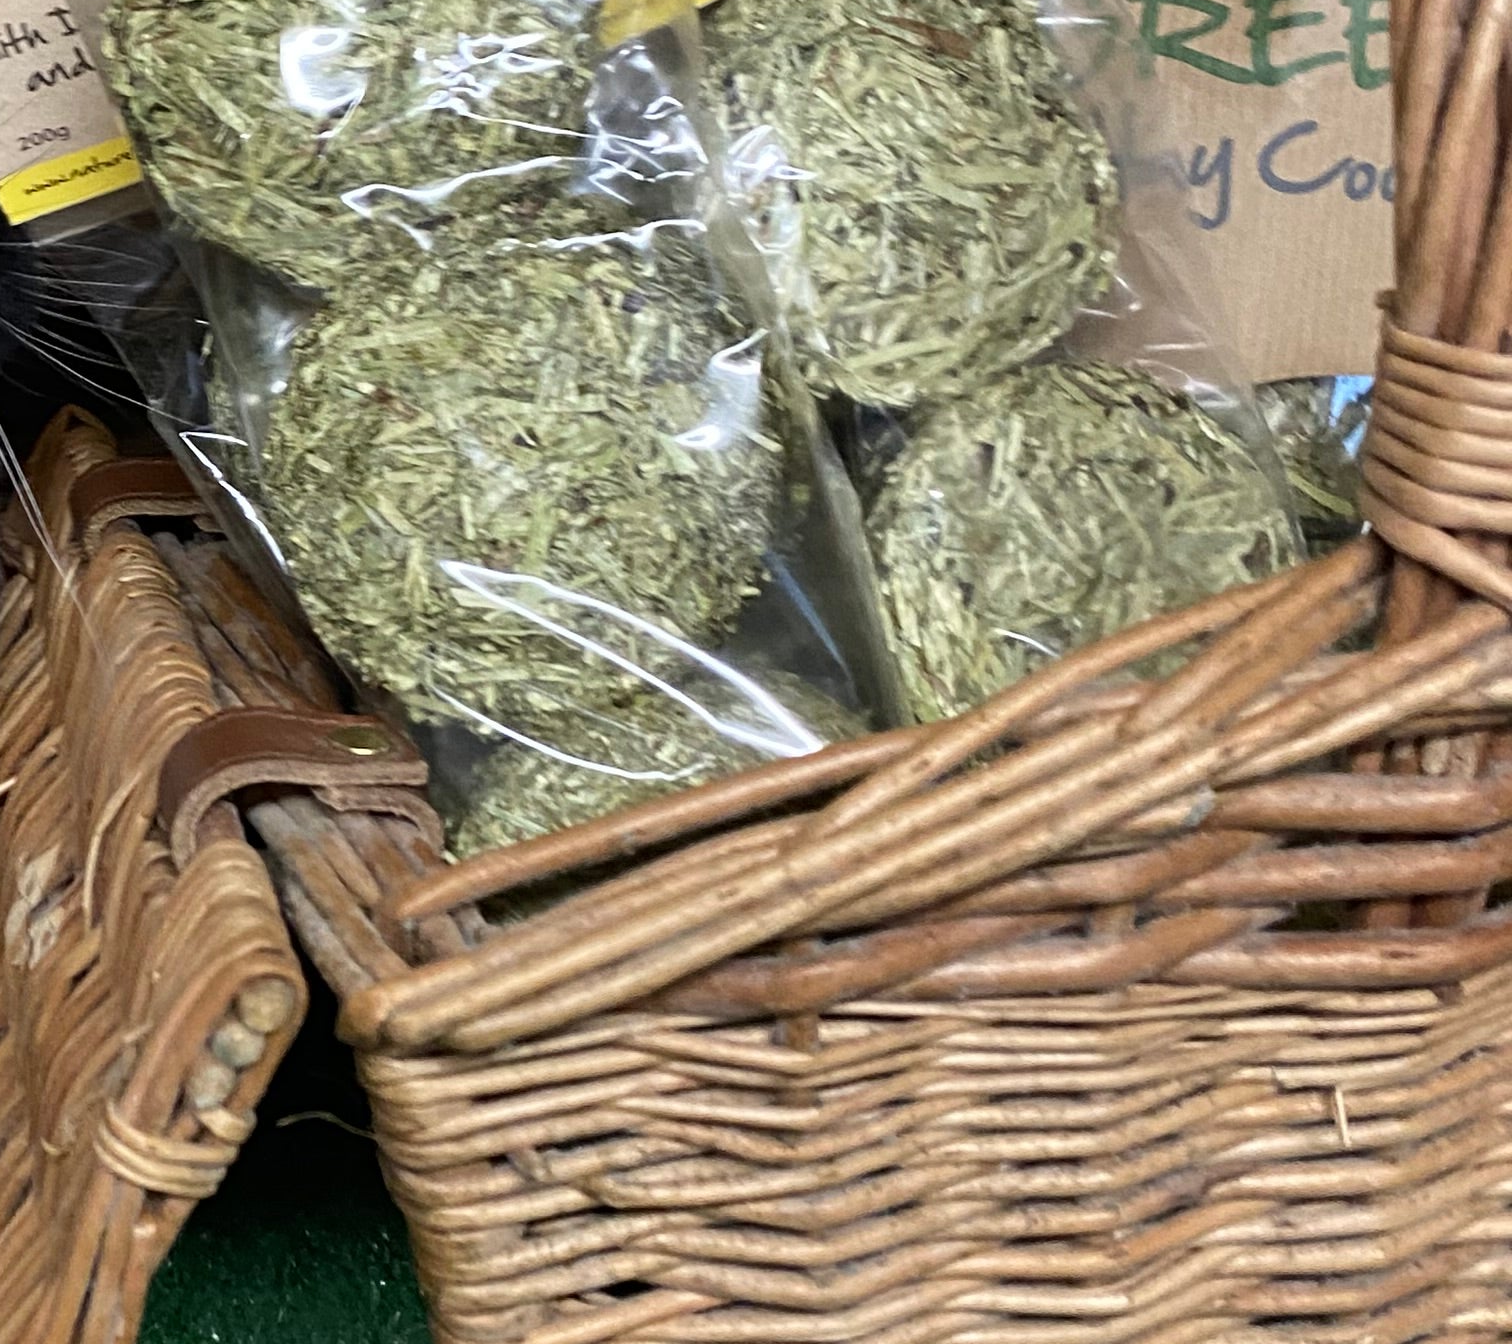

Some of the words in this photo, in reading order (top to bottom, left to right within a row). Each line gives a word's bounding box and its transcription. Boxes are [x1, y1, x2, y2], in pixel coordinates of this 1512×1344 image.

[27, 47, 96, 91] and
[16, 126, 71, 151] 200g
[1257, 119, 1395, 202] Coo
